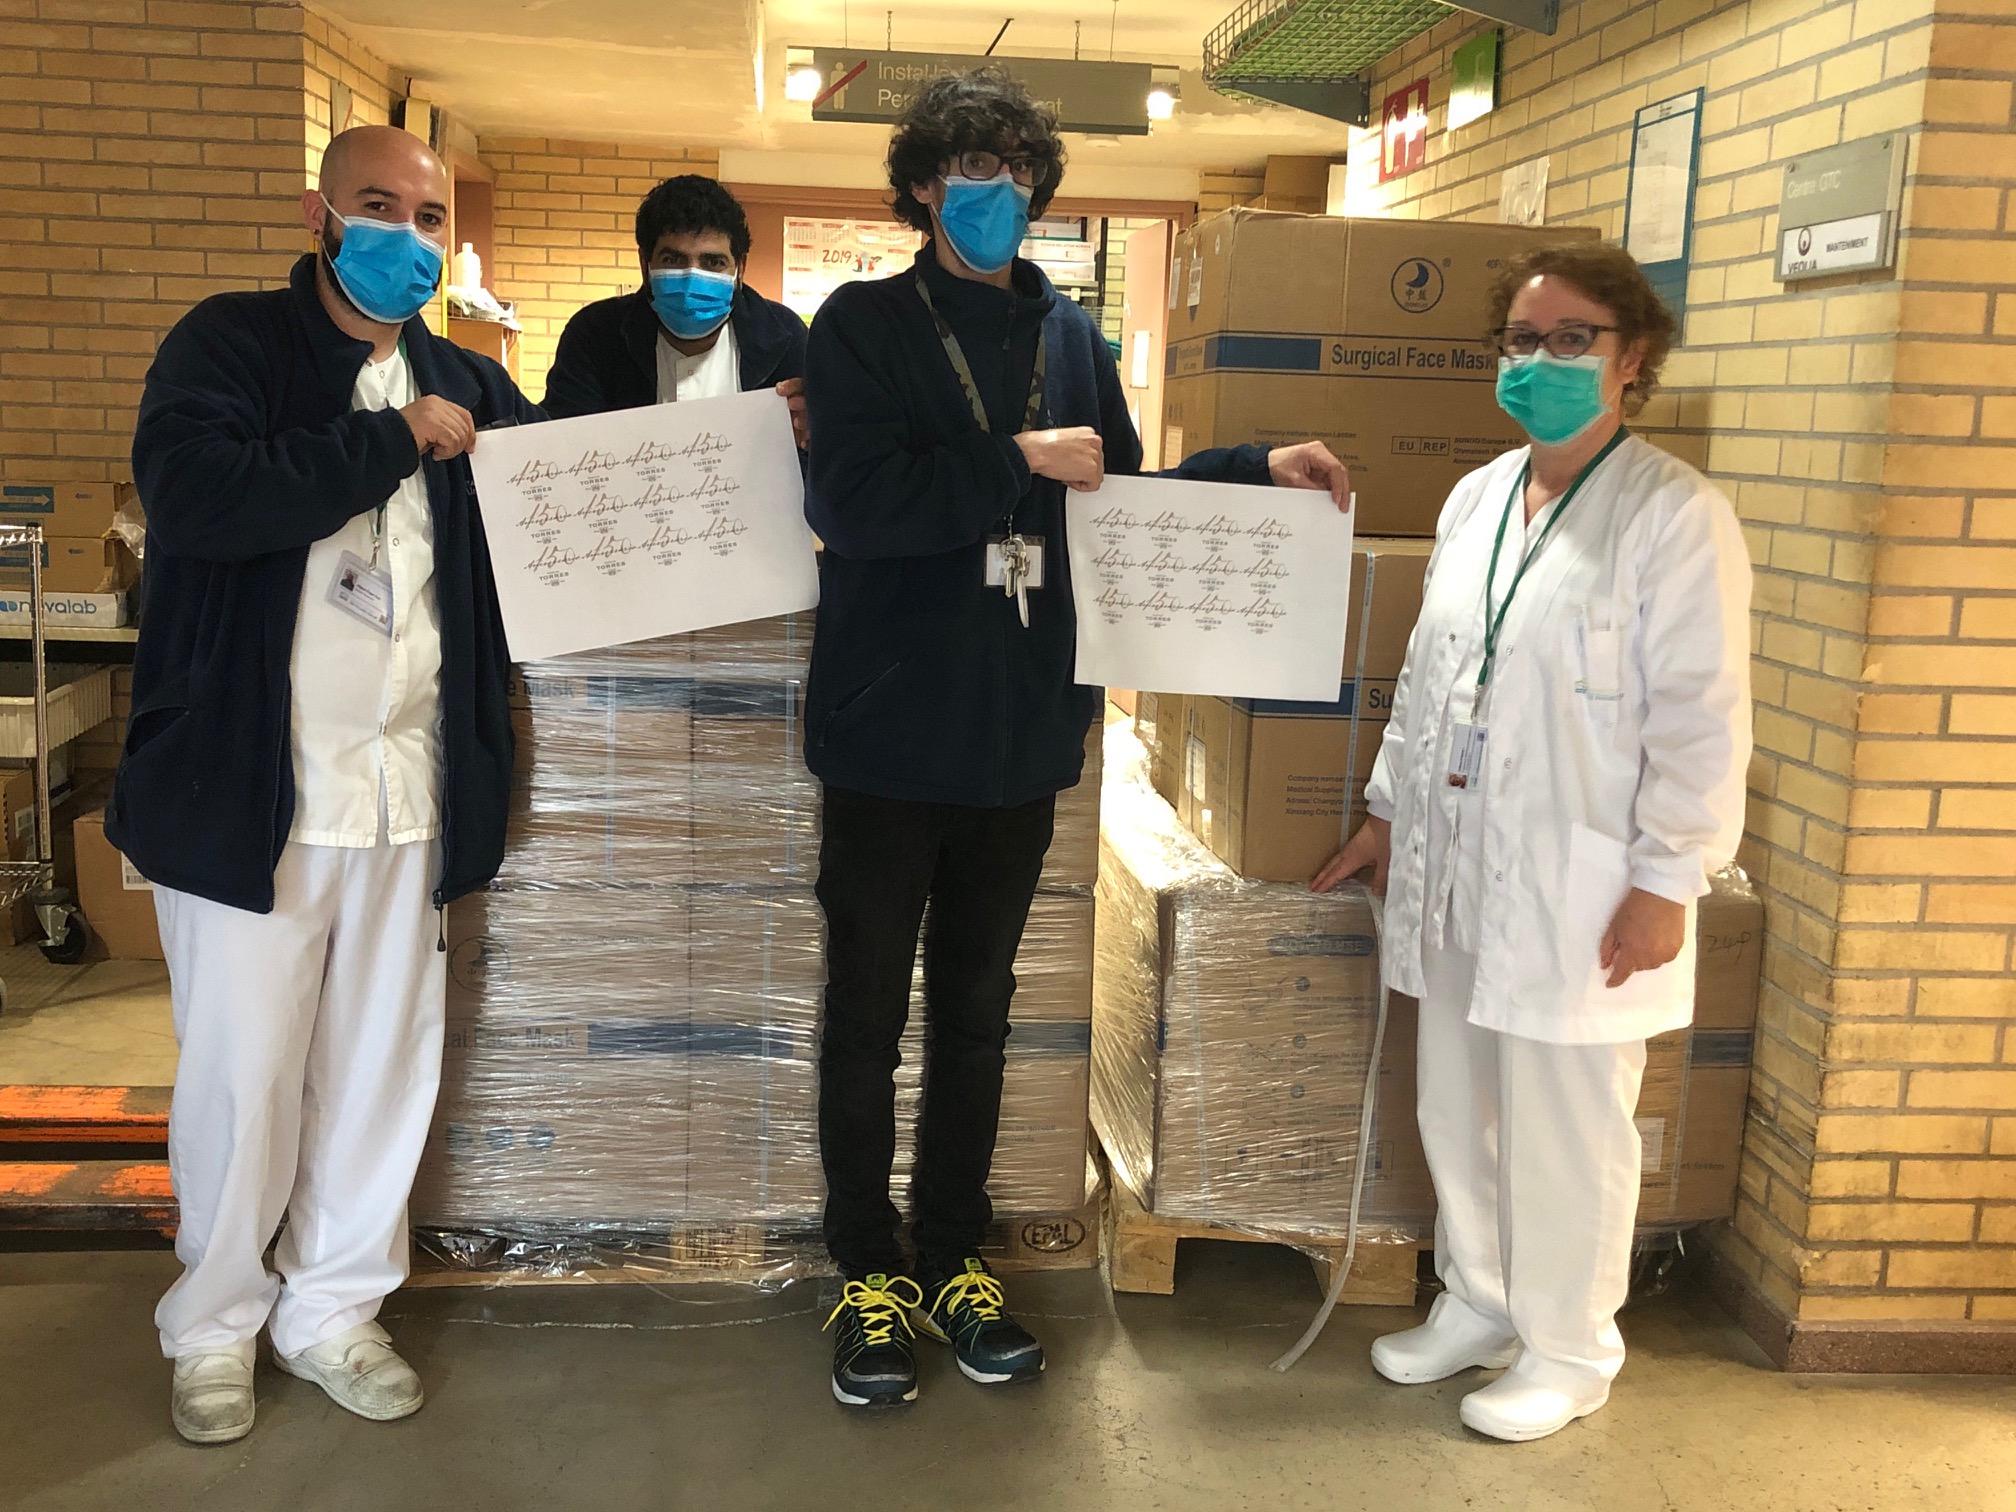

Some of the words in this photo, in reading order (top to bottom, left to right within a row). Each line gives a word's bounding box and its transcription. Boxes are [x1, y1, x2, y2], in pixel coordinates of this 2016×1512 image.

[1820, 169, 1842, 192] GTC
[822, 249, 852, 263] 2019
[1331, 343, 1401, 371] Surgical
[1405, 346, 1446, 369] Face
[1398, 441, 1415, 451] EU
[1423, 442, 1447, 452] REP
[693, 458, 722, 467] TORRES
[636, 467, 666, 477] TORRES
[580, 476, 610, 486] TORRES
[522, 486, 553, 496] TORRES
[701, 500, 730, 509] TORRES
[644, 509, 674, 519] TORRES
[588, 519, 618, 528] TORRES
[530, 529, 561, 539] TORRES
[709, 542, 738, 551] TORRES
[652, 551, 682, 561] TORRES
[596, 560, 626, 570] TORRES
[539, 571, 569, 581] TORRES
[19, 599, 97, 615] nvalab
[1031, 1223, 1075, 1245] EPAL
